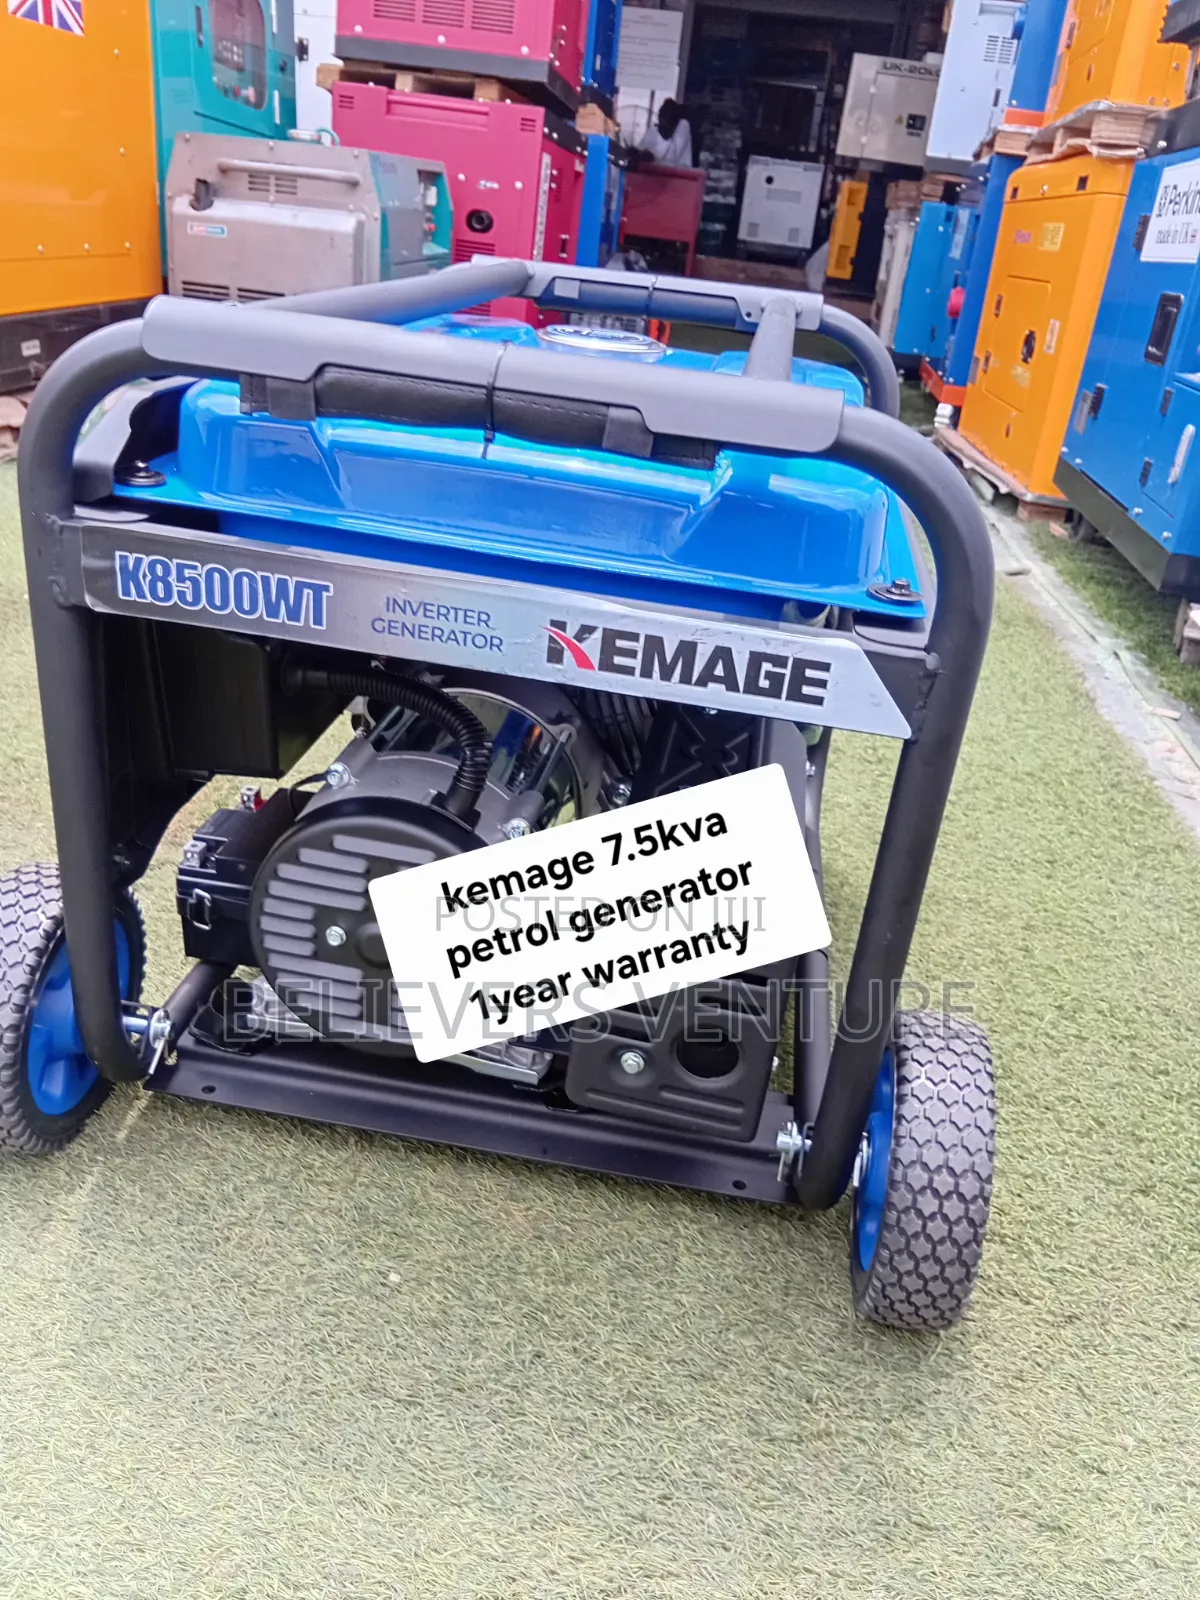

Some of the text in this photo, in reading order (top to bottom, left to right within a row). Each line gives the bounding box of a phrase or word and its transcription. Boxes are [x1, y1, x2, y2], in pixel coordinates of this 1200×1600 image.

[114, 551, 333, 629] K8500WT
[385, 597, 492, 628] INVERTER
[371, 618, 504, 653] GENERATOR
[540, 619, 832, 707] KEMAGE
